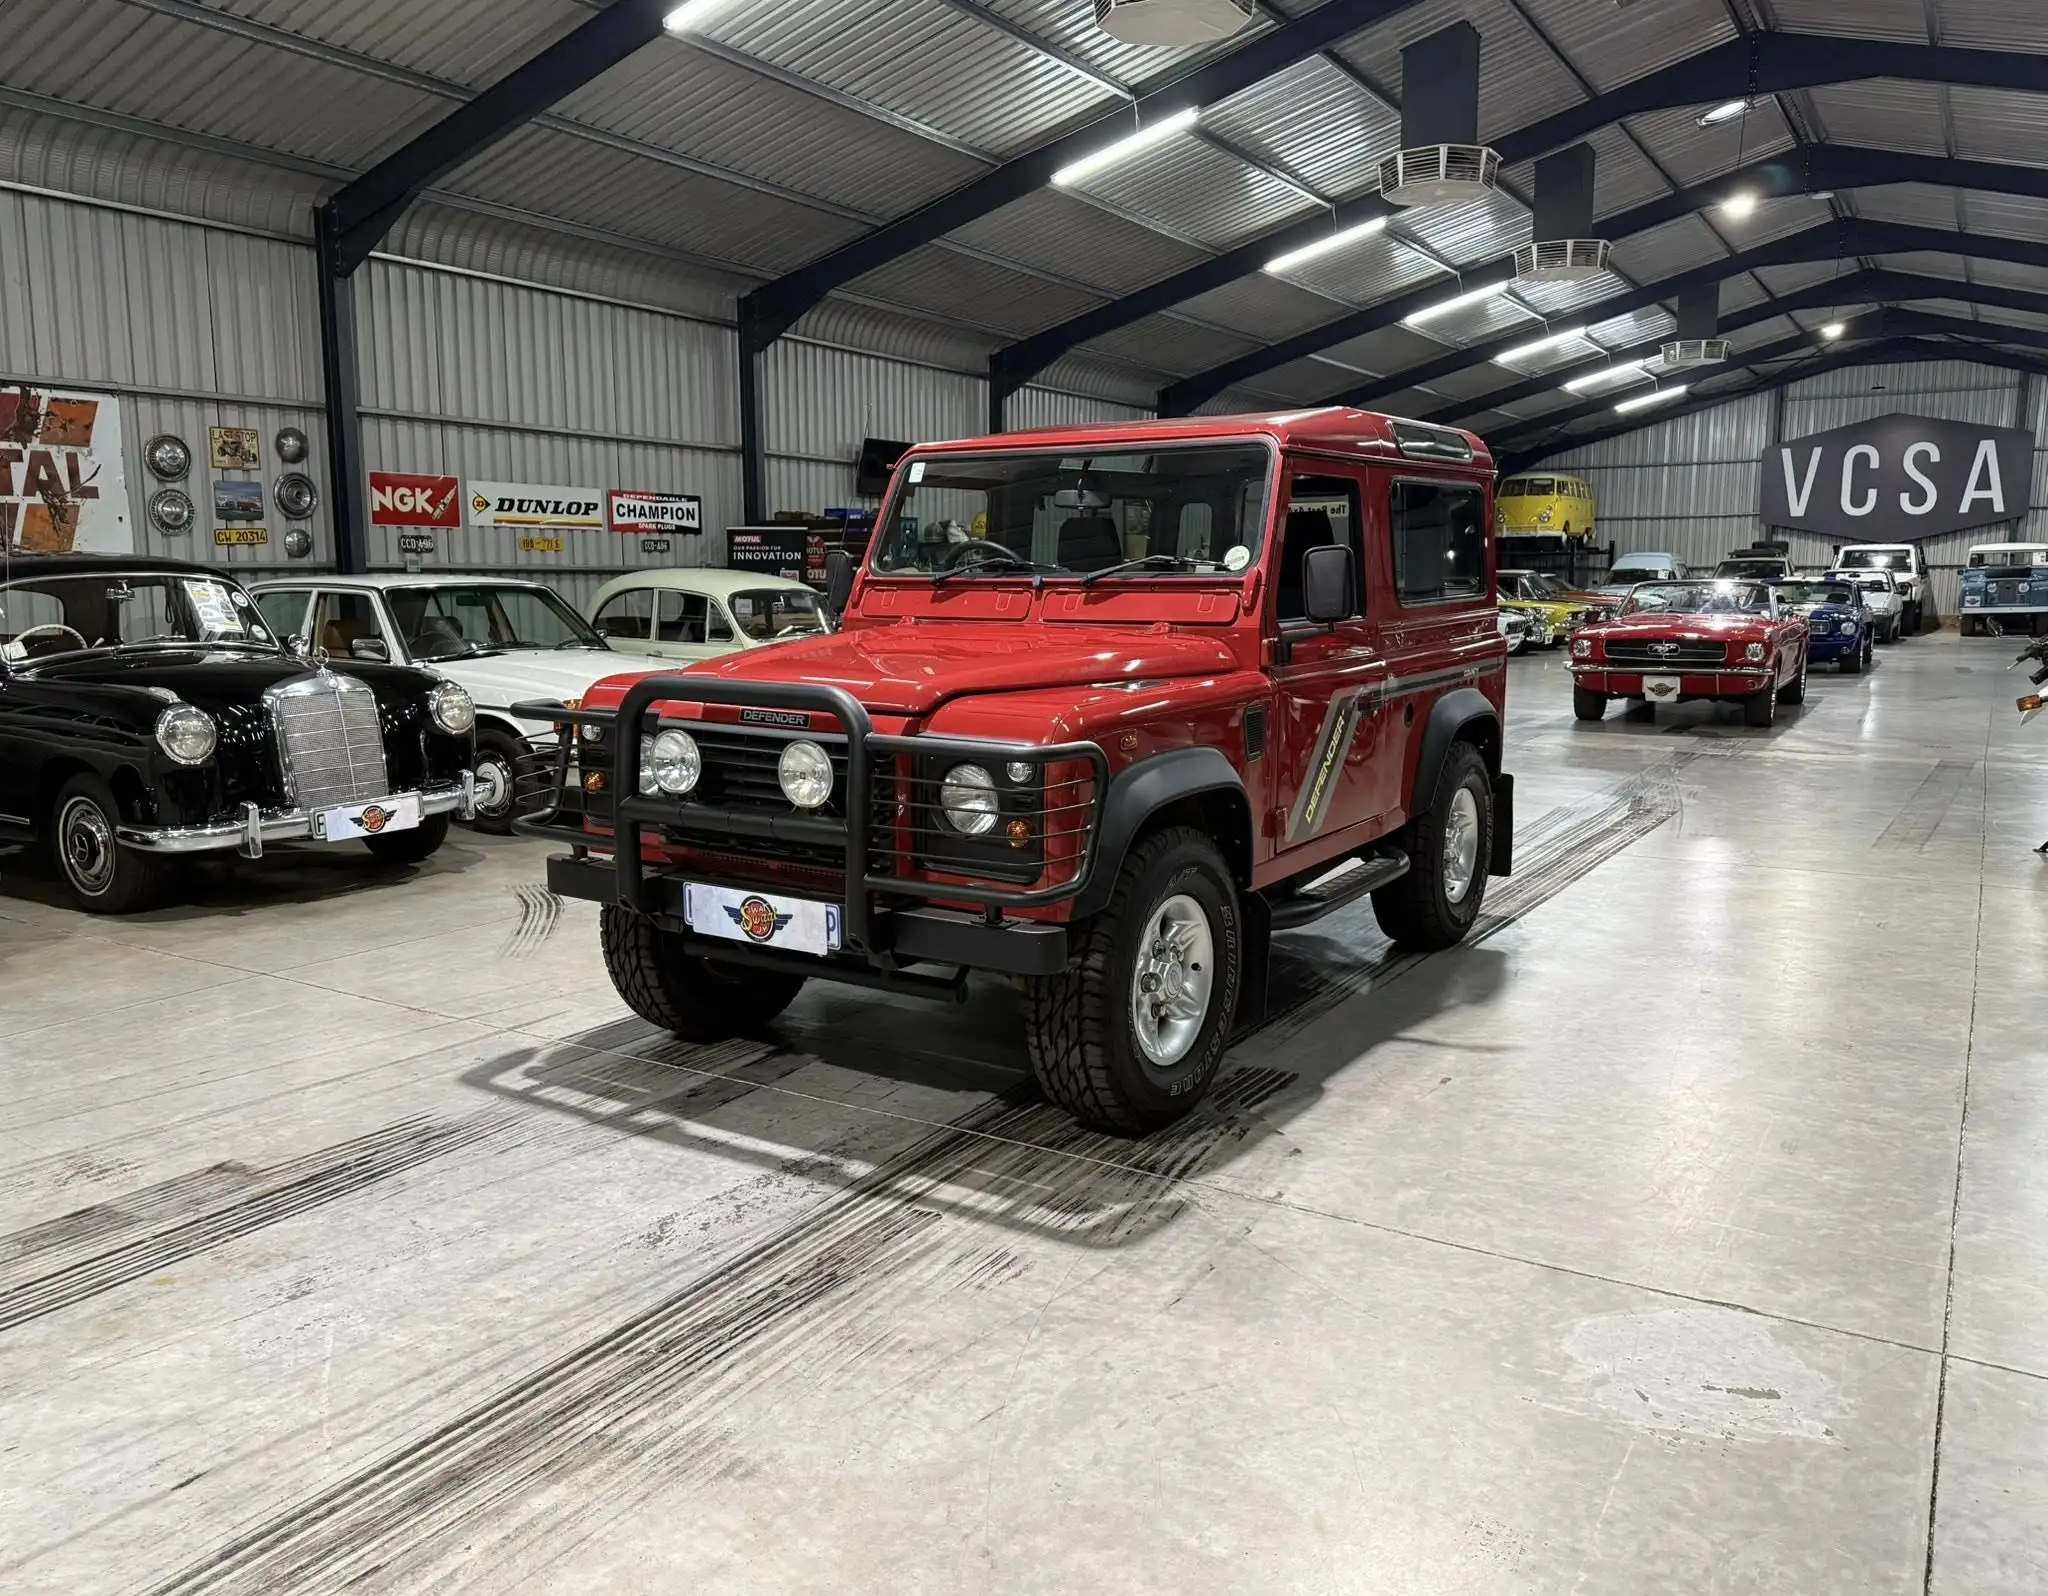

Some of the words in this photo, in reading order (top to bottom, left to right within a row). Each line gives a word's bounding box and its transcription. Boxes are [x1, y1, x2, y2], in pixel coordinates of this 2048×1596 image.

[1781, 439, 2005, 517] VCSA
[371, 484, 434, 514] NGK
[622, 493, 688, 502] DEPENDABLE
[495, 497, 599, 516] DUNLOP
[616, 502, 696, 521] CHAMPION
[236, 530, 266, 542] 20314
[734, 535, 761, 543] MOTUL
[733, 551, 802, 560] INNOVATION
[743, 710, 806, 725] DEFENDER
[1305, 718, 1346, 824] DEFENDER
